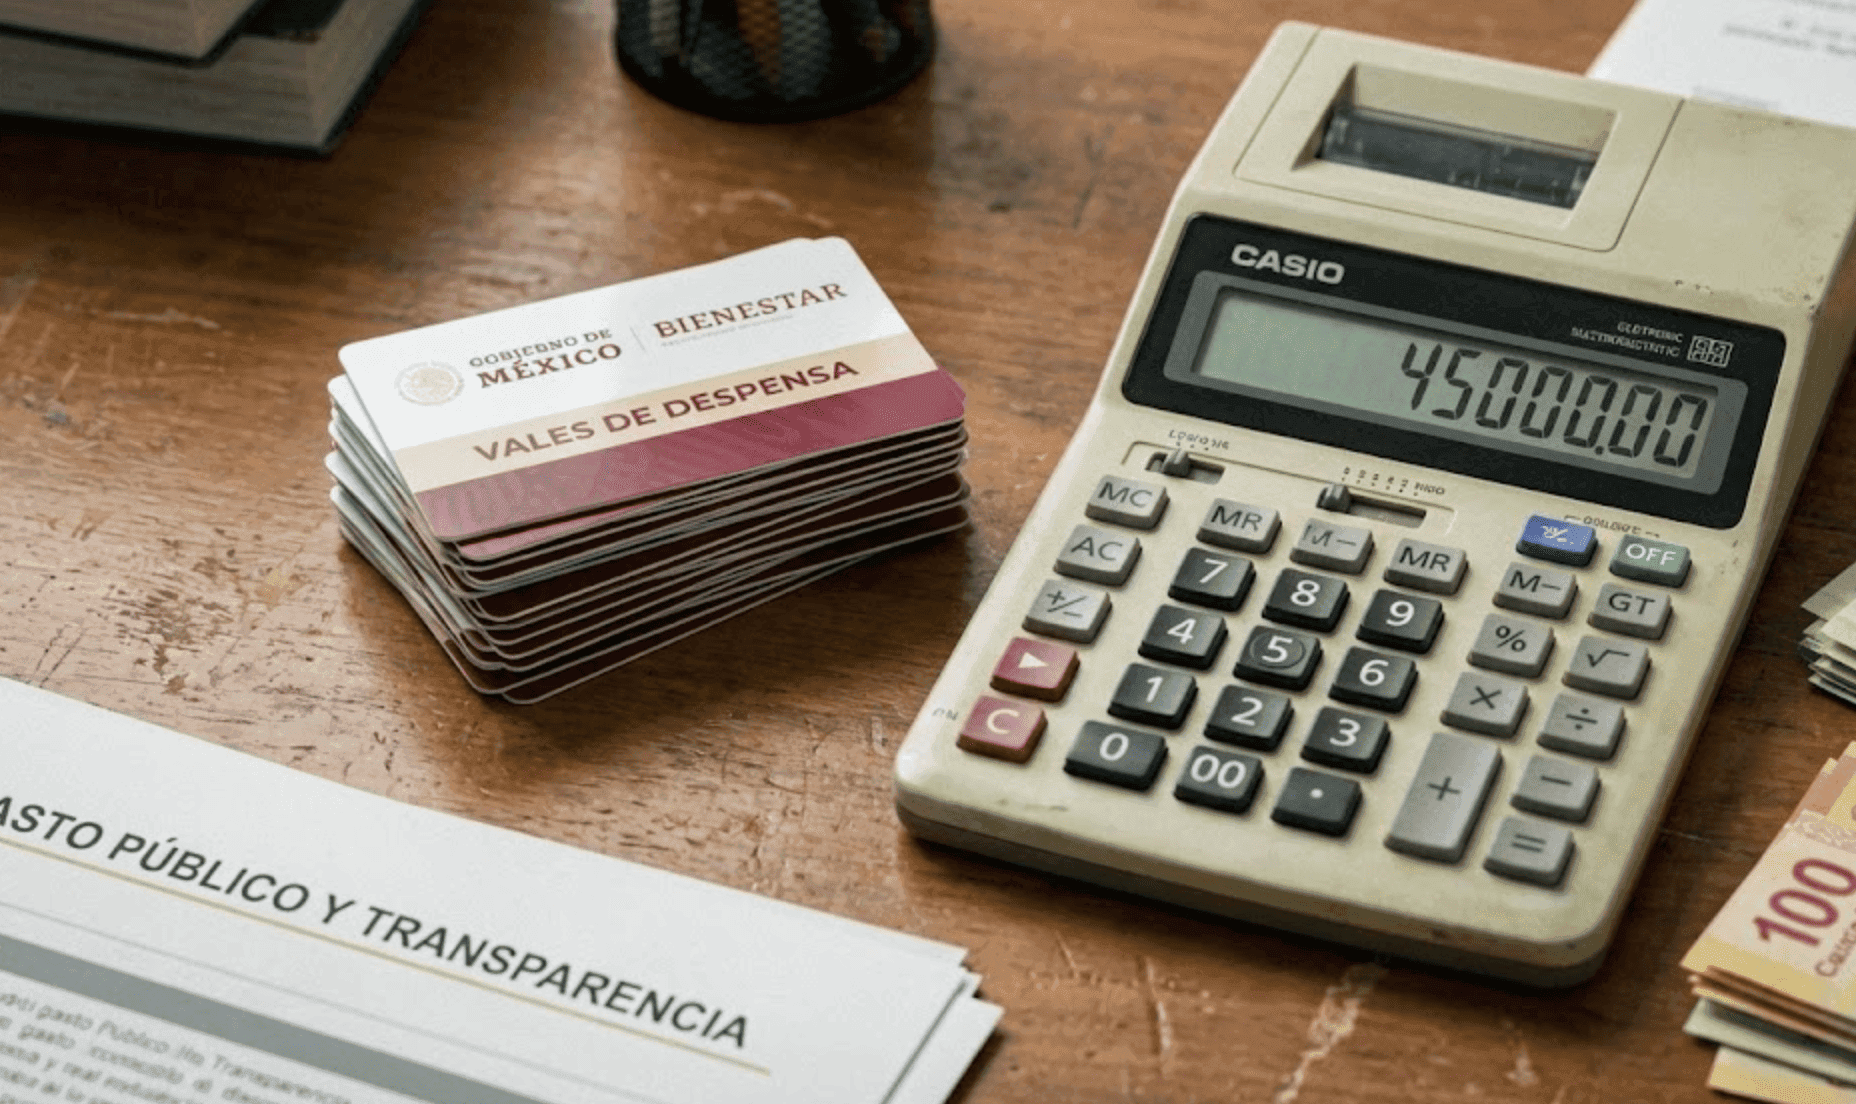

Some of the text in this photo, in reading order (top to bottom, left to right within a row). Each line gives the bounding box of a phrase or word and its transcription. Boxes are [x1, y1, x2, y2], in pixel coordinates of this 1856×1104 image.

[1231, 243, 1345, 286] CASIO
[653, 283, 848, 338] BIENESTAR
[582, 328, 612, 343] DE
[477, 342, 622, 388] MÉXICO
[473, 360, 860, 462] VALES DE DESPENSA
[1400, 340, 1708, 467] 45000.00
[1097, 481, 1152, 508] MC
[1210, 504, 1264, 531] MR
[1070, 536, 1123, 561] AC
[1399, 549, 1450, 573] MR
[1626, 543, 1677, 566] OFF
[1200, 558, 1228, 586] 7
[1292, 578, 1318, 606] 8
[1608, 592, 1656, 615] GT
[1386, 600, 1414, 628] 9
[1167, 618, 1194, 643] 4
[1493, 624, 1527, 653] %
[1261, 637, 1289, 664] 5
[1358, 659, 1386, 686] 6
[1143, 676, 1162, 702] 1
[986, 708, 1021, 735] C
[1231, 697, 1260, 726] 2
[1100, 732, 1130, 762] 0
[1329, 720, 1357, 747] 3
[1191, 755, 1245, 789] 00
[1753, 857, 1856, 948] 100
[108, 837, 310, 912] PÚBLICO
[322, 894, 355, 926] Y
[361, 906, 750, 1048] TRANSPARENCIA
